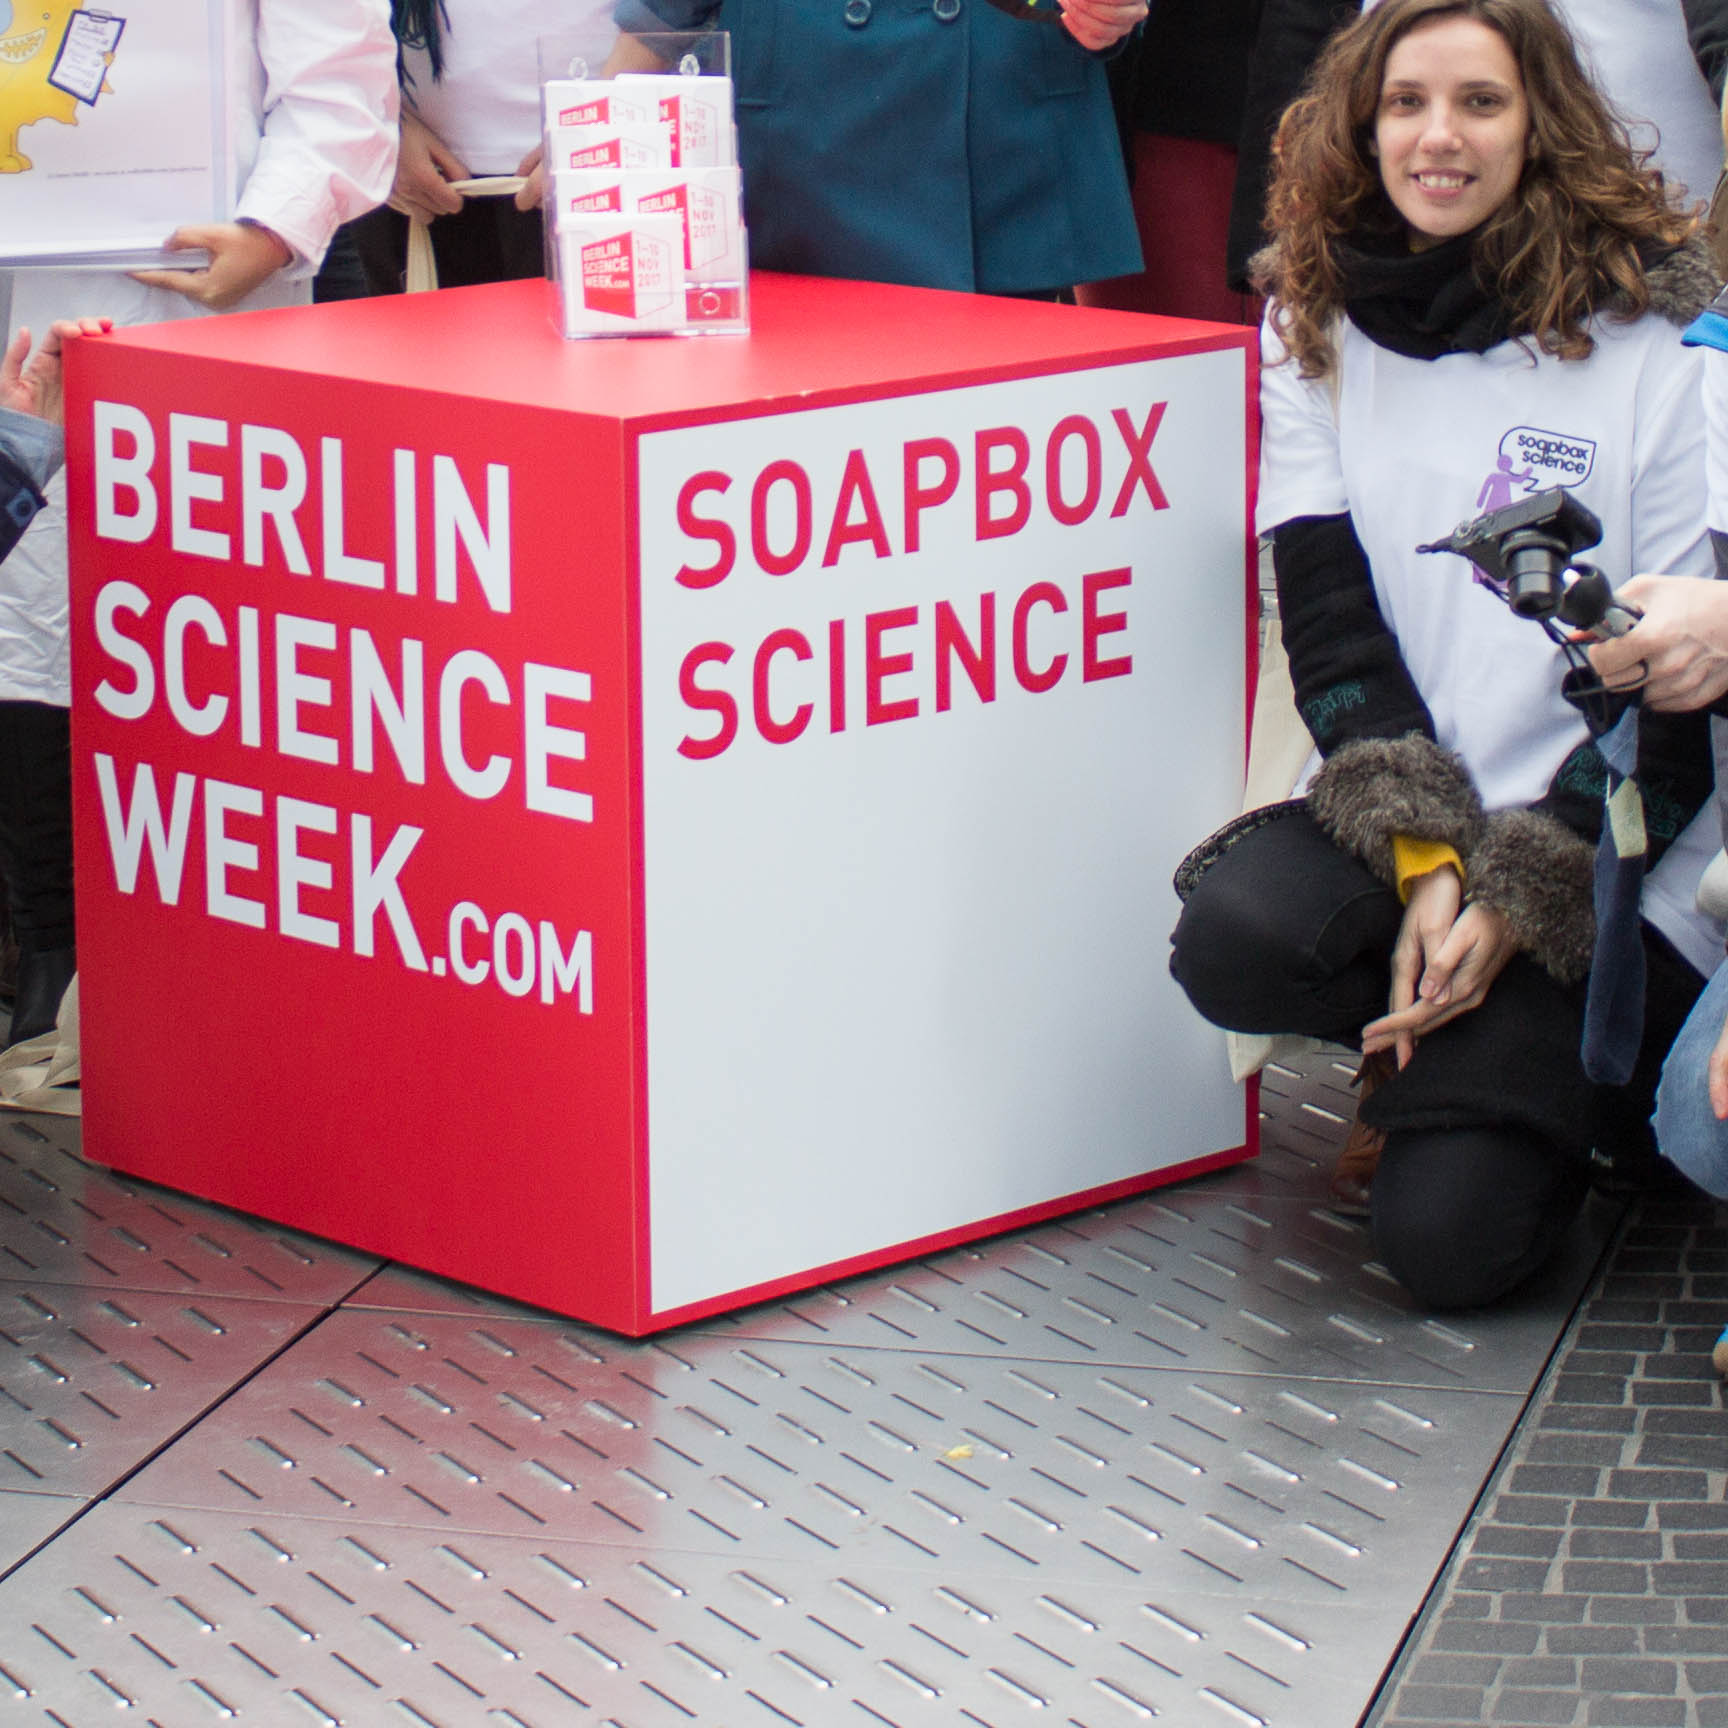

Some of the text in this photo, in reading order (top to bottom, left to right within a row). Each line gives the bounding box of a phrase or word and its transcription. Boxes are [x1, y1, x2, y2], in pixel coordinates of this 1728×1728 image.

[584, 241, 621, 261] BERLIN
[584, 256, 630, 274] SCIENCE
[93, 400, 511, 612] BERLIN
[675, 401, 1170, 589] SOAPBOX
[1518, 434, 1589, 460] soapbox
[1523, 450, 1586, 474] science
[93, 580, 594, 823] SCIENCE
[676, 566, 1133, 761] SCIENCE
[94, 752, 594, 1015] WEEK.COM
